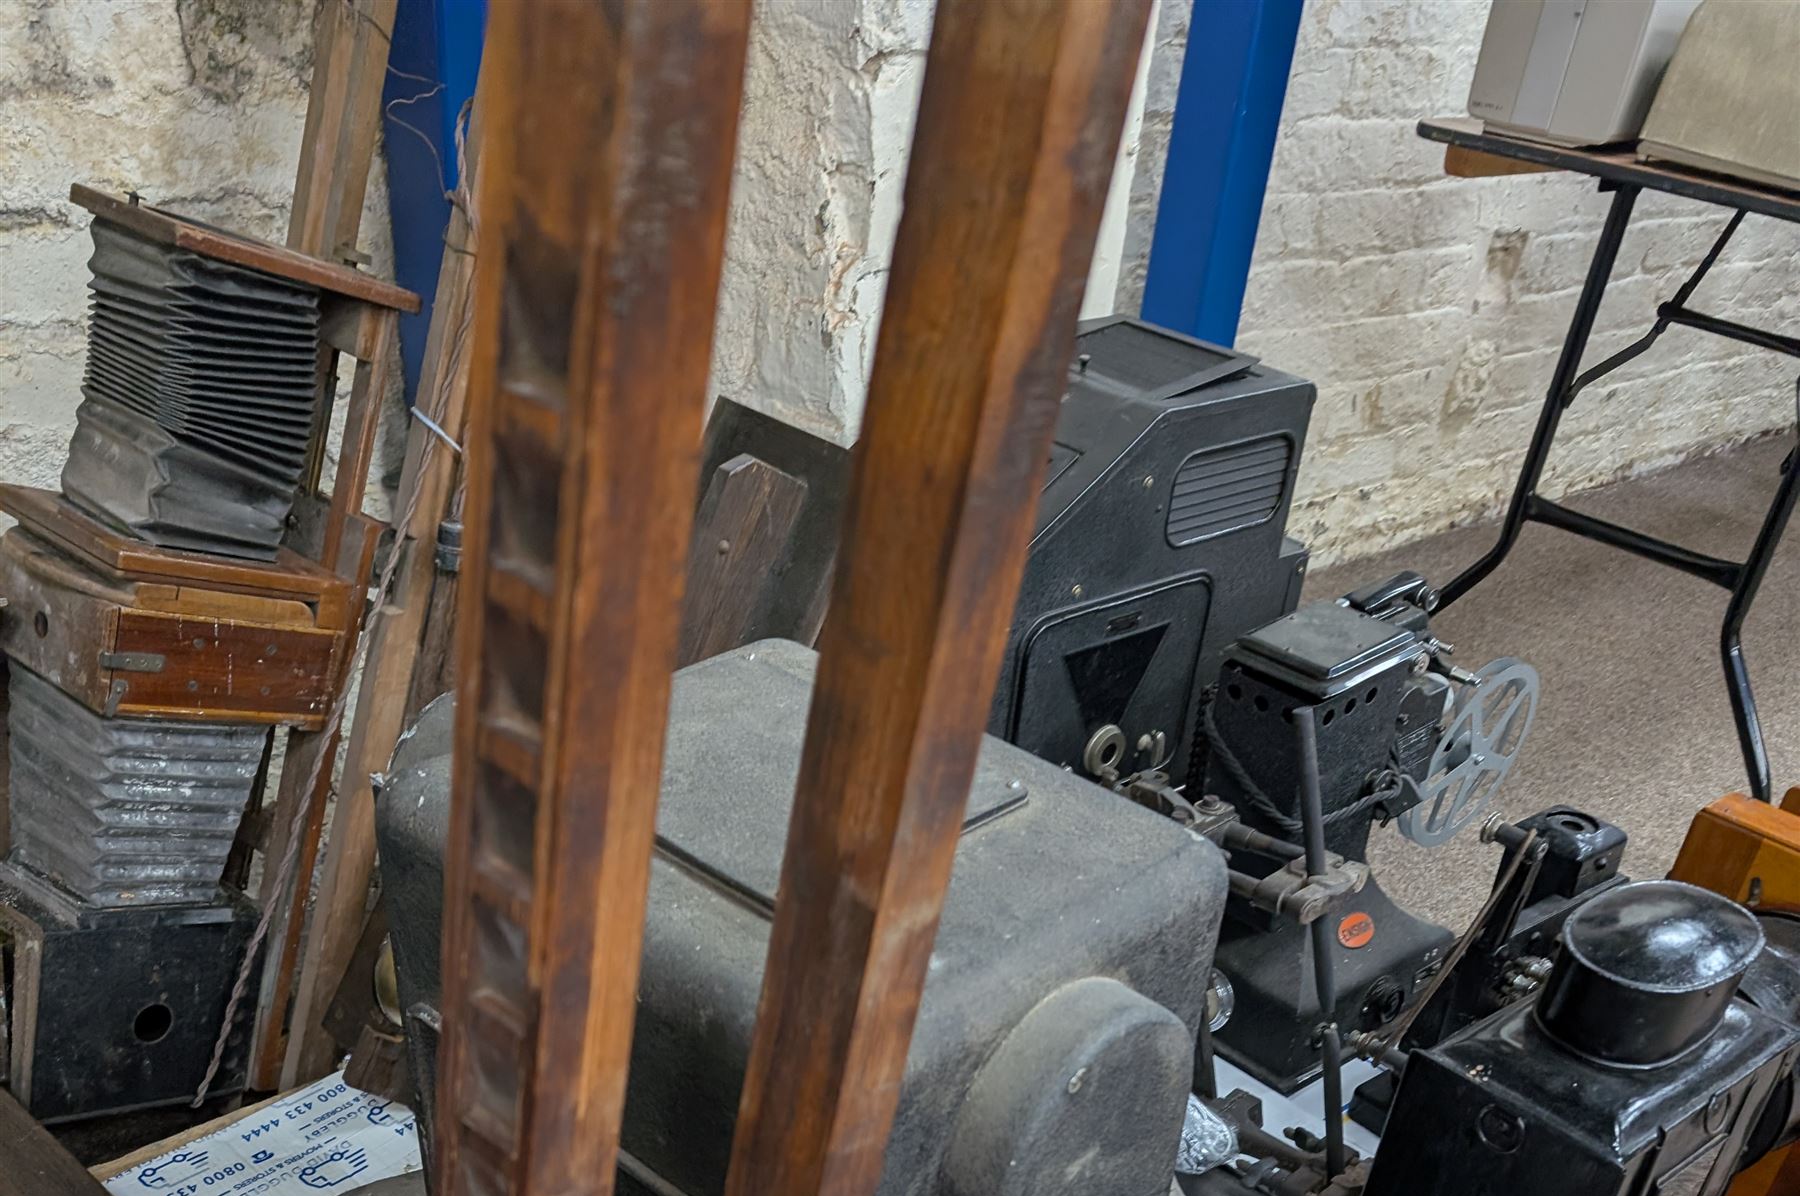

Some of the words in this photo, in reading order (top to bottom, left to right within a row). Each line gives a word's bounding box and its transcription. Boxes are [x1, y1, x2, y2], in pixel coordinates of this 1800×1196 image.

[284, 1100, 314, 1122] 433
[303, 1098, 378, 1143] DUGGLEBY
[313, 1100, 353, 1124] STORERS
[241, 1117, 282, 1144] 4444
[394, 1118, 419, 1138] 44
[284, 1142, 323, 1166] MOVERS
[306, 1139, 352, 1168] DAVID
[202, 1161, 246, 1187] 0800
[232, 1165, 276, 1192] STORERS
